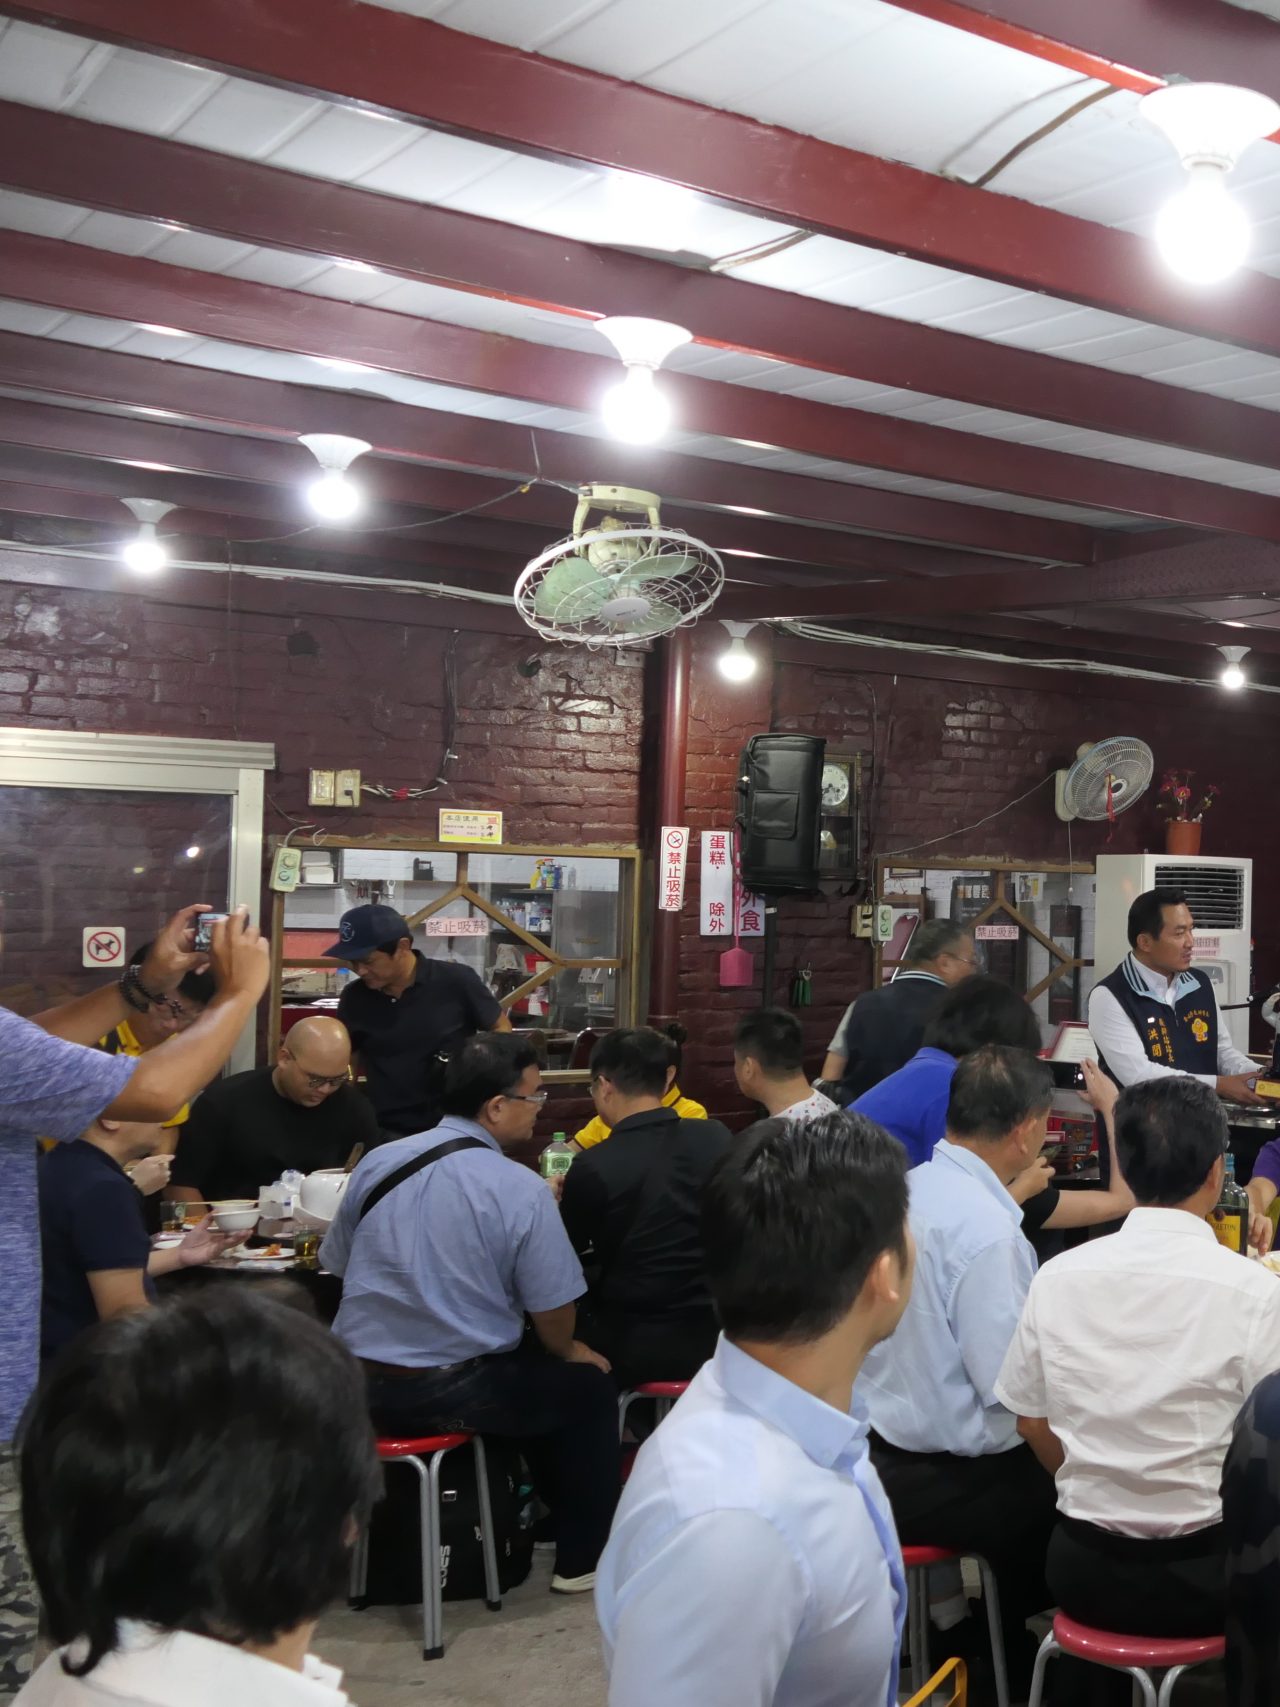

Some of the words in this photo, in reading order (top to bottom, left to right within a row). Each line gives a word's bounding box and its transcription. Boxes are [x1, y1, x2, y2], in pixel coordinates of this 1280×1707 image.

[665, 852, 682, 907] 禁止吸菸
[428, 920, 487, 934] 禁止吸菸
[709, 902, 725, 932] 除外
[977, 926, 1017, 938] 禁止吸菸
